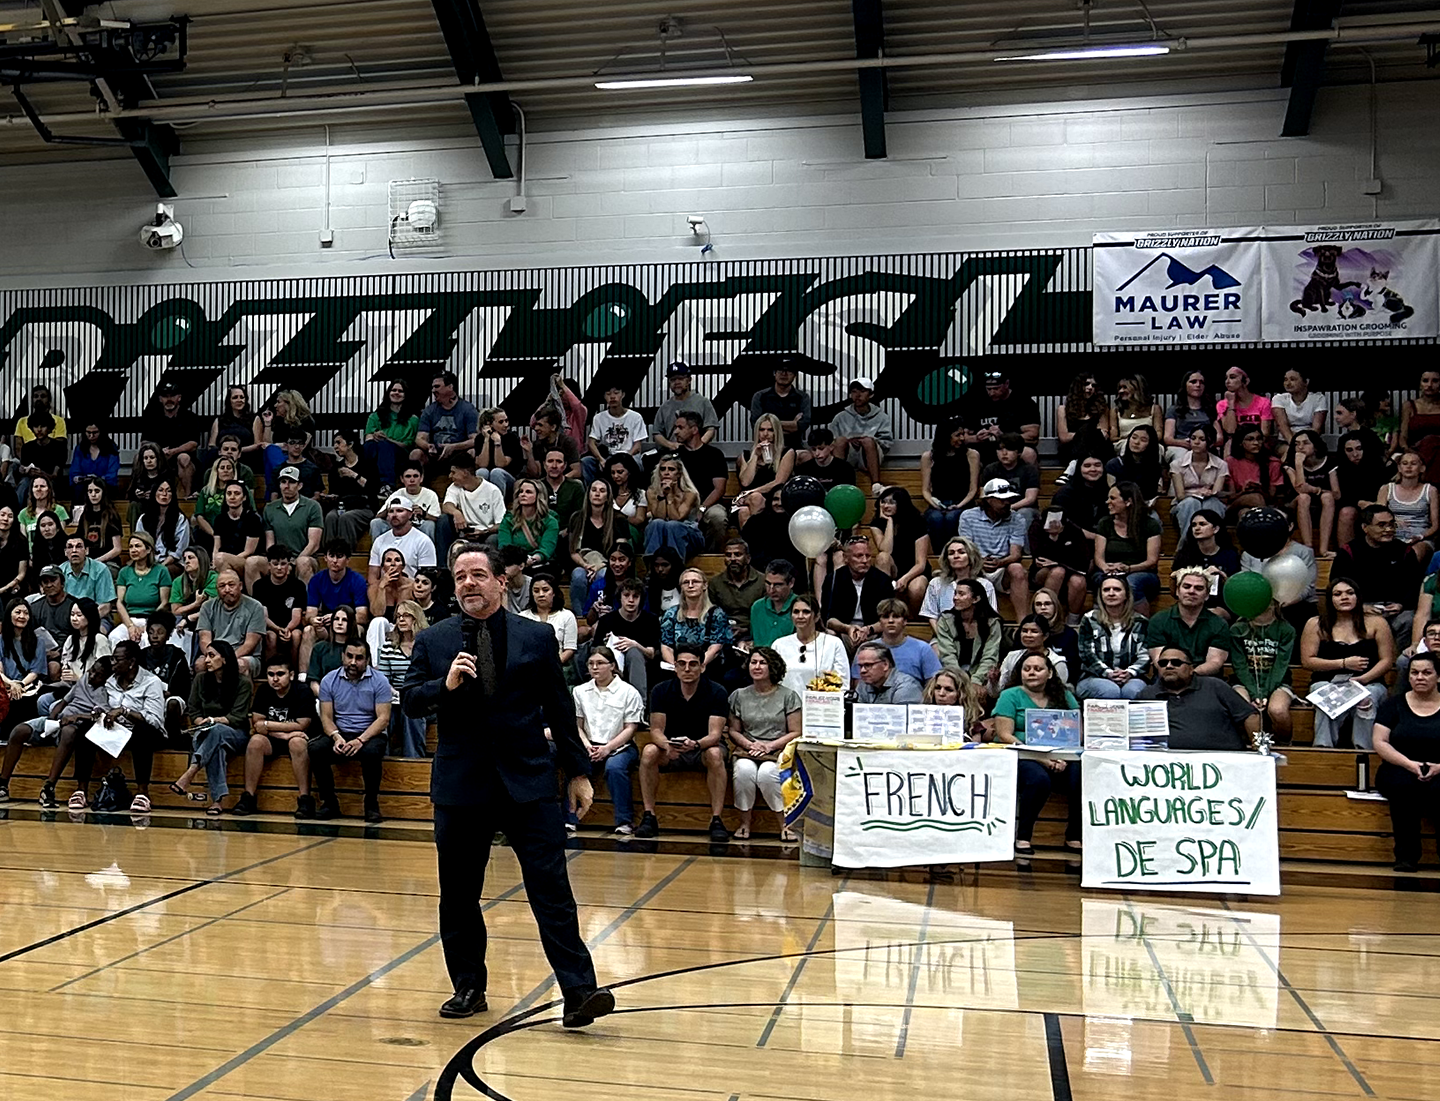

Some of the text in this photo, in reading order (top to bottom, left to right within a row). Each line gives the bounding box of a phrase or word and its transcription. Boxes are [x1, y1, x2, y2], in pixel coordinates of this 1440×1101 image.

[1135, 237, 1219, 248] GRIZZLY NATION
[1305, 229, 1394, 241] GRIZZLY NATION
[1115, 293, 1242, 313] MAURER
[1151, 315, 1208, 330] LAW
[1294, 322, 1407, 332] INSPAWRATION GROOMING
[1120, 762, 1223, 791] WORLD
[863, 771, 993, 819] FRENCH
[1088, 795, 1267, 830] LANGUAGES/
[1115, 837, 1242, 878] DE SPA
